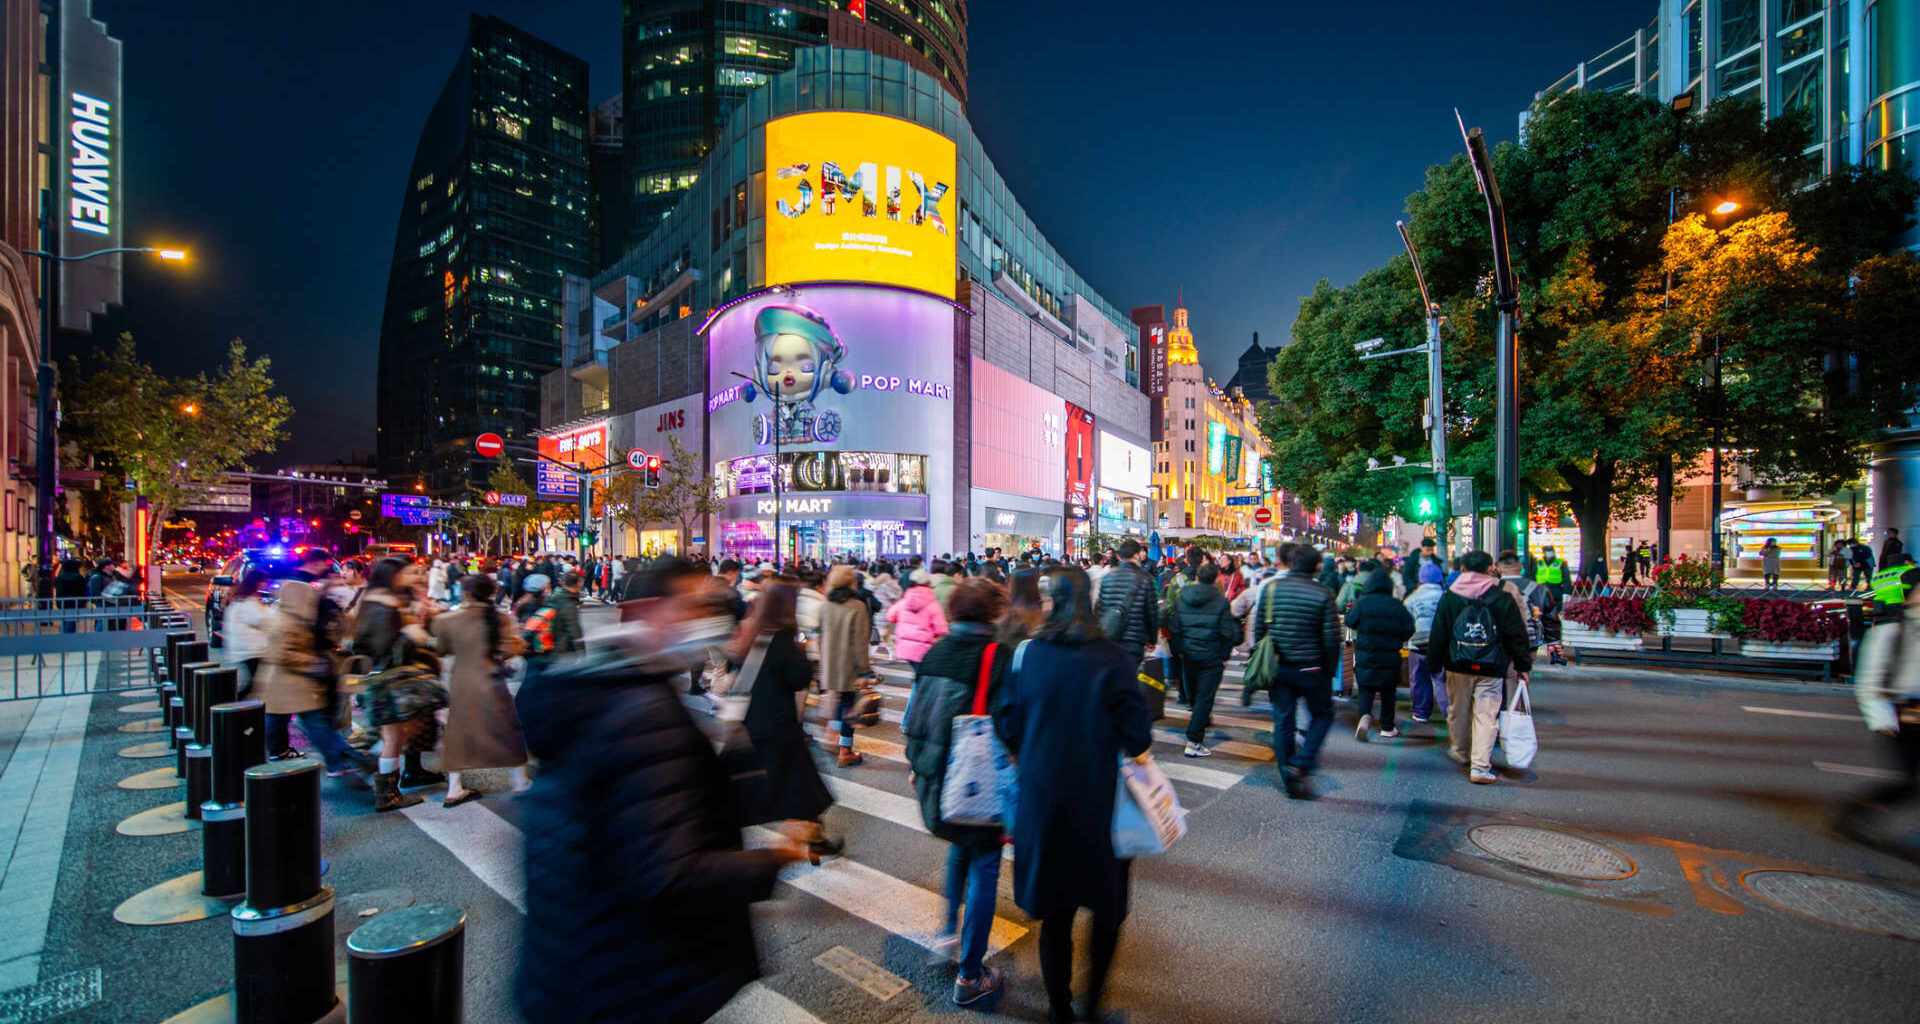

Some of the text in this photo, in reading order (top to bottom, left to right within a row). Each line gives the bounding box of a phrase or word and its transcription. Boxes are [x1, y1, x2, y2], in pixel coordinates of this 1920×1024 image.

[72, 92, 110, 236] HUAWEI
[718, 386, 740, 406] MART
[861, 375, 952, 399] POP MART
[656, 409, 685, 432] JINS
[632, 454, 645, 465] 40
[757, 499, 832, 514] POP MART
